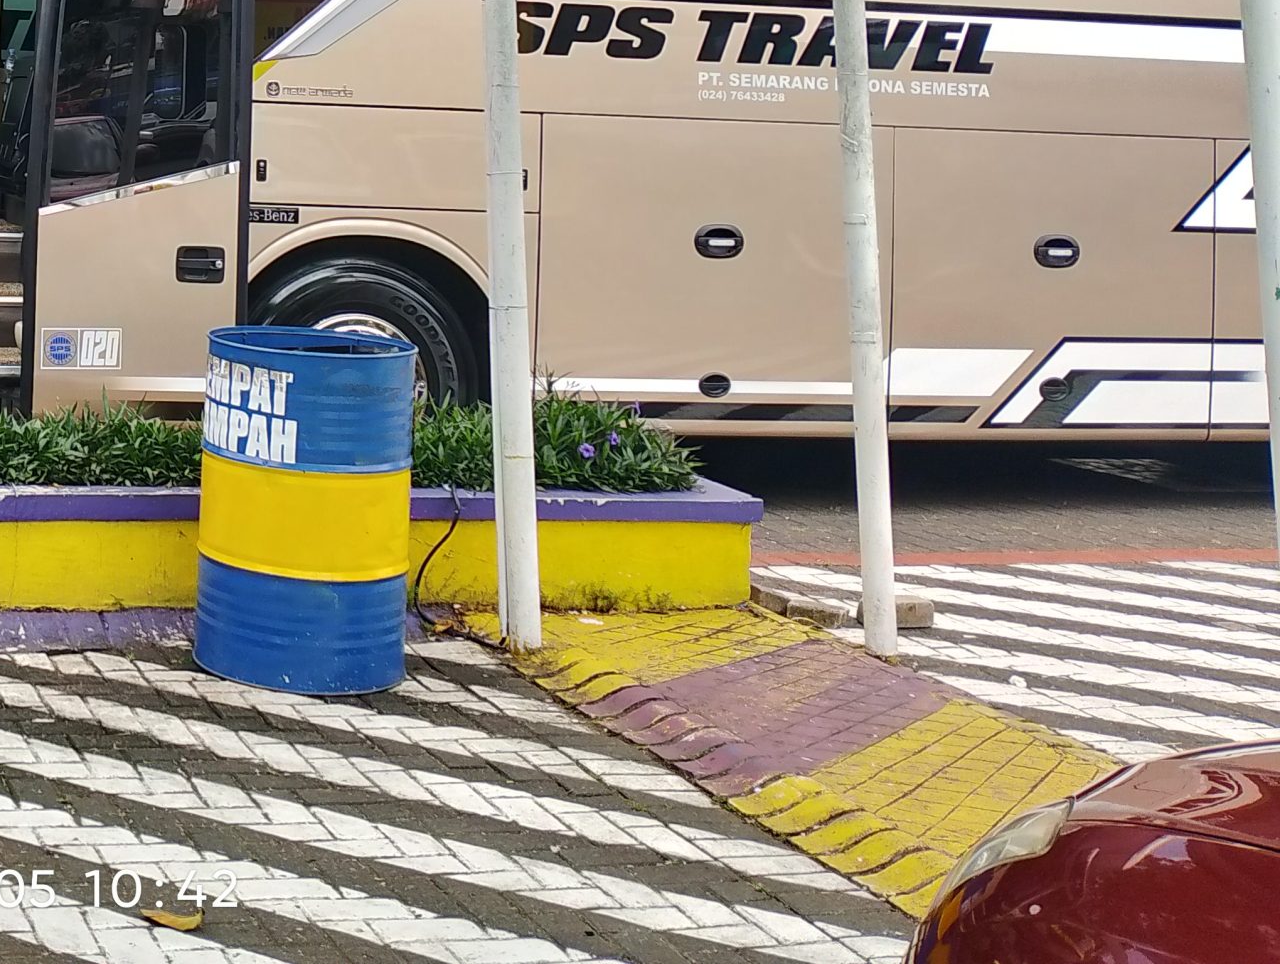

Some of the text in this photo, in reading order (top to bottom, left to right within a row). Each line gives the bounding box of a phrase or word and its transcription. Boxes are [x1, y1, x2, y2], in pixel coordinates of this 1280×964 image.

[517, 1, 994, 75] SPS TRAVEL
[698, 72, 723, 86] PT.
[729, 73, 829, 90] SEMARANG
[910, 81, 990, 97] SEMESTA
[698, 89, 727, 101] (024)
[80, 330, 120, 367] 020
[206, 353, 294, 417] EMPAT
[203, 397, 298, 464] AMPAH
